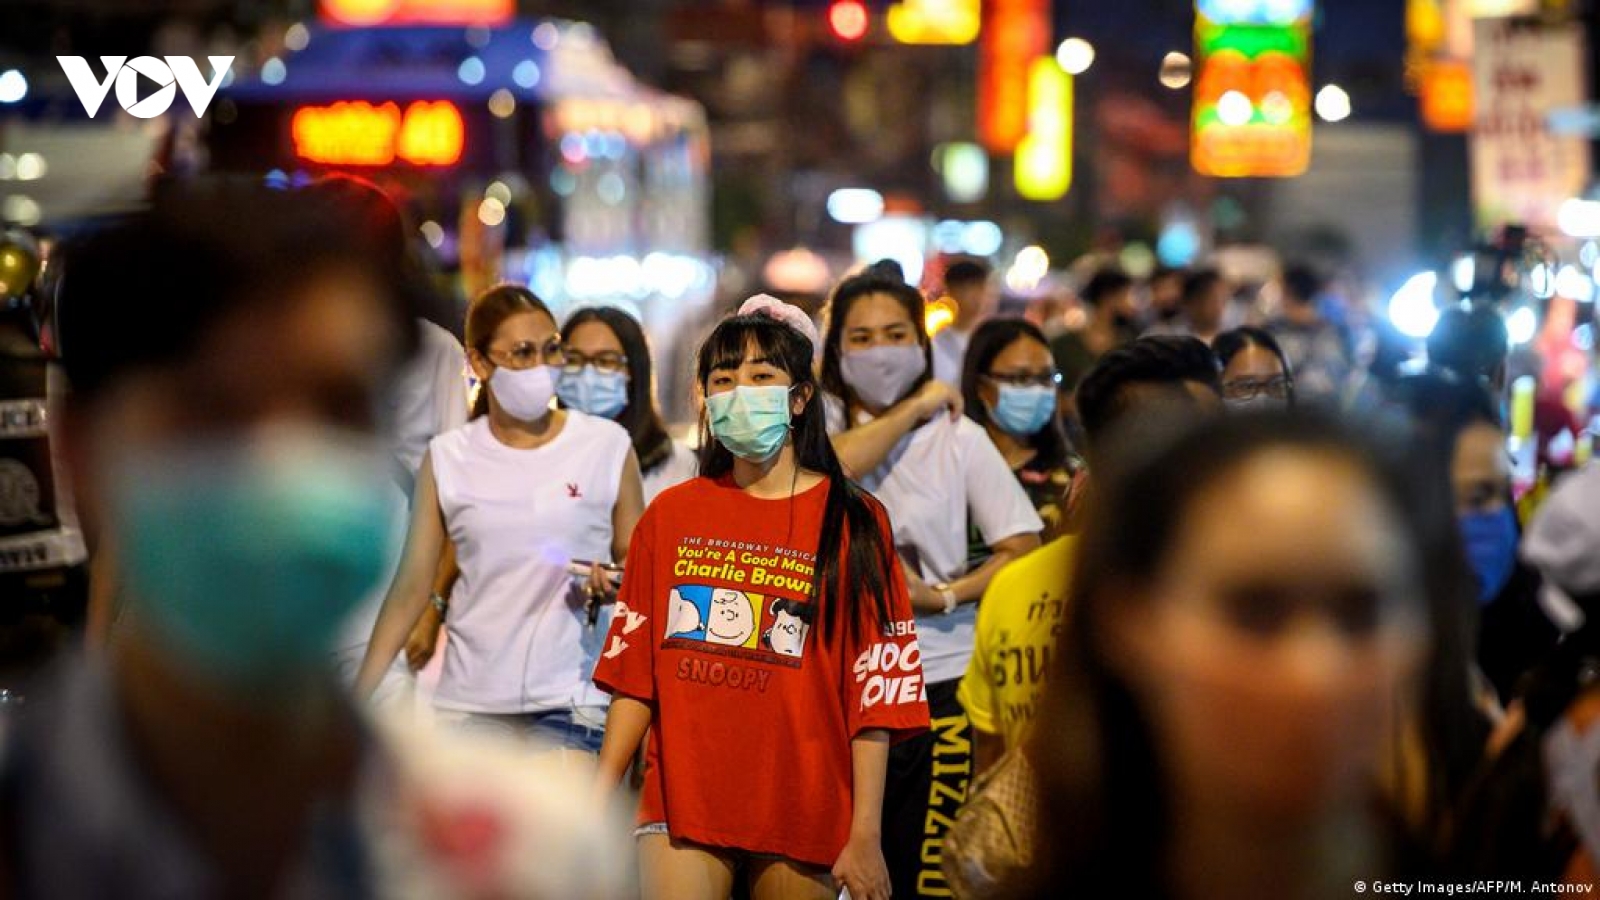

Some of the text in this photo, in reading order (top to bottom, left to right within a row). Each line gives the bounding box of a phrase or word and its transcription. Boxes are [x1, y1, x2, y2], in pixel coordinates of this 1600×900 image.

[683, 536, 703, 546] THE
[708, 538, 770, 553] BROADWAY
[677, 546, 721, 560] You're
[725, 549, 737, 563] A
[741, 552, 778, 568] Good
[674, 559, 746, 582] Charlie
[676, 656, 770, 693] SNOOPY
[860, 675, 928, 713] OVE
